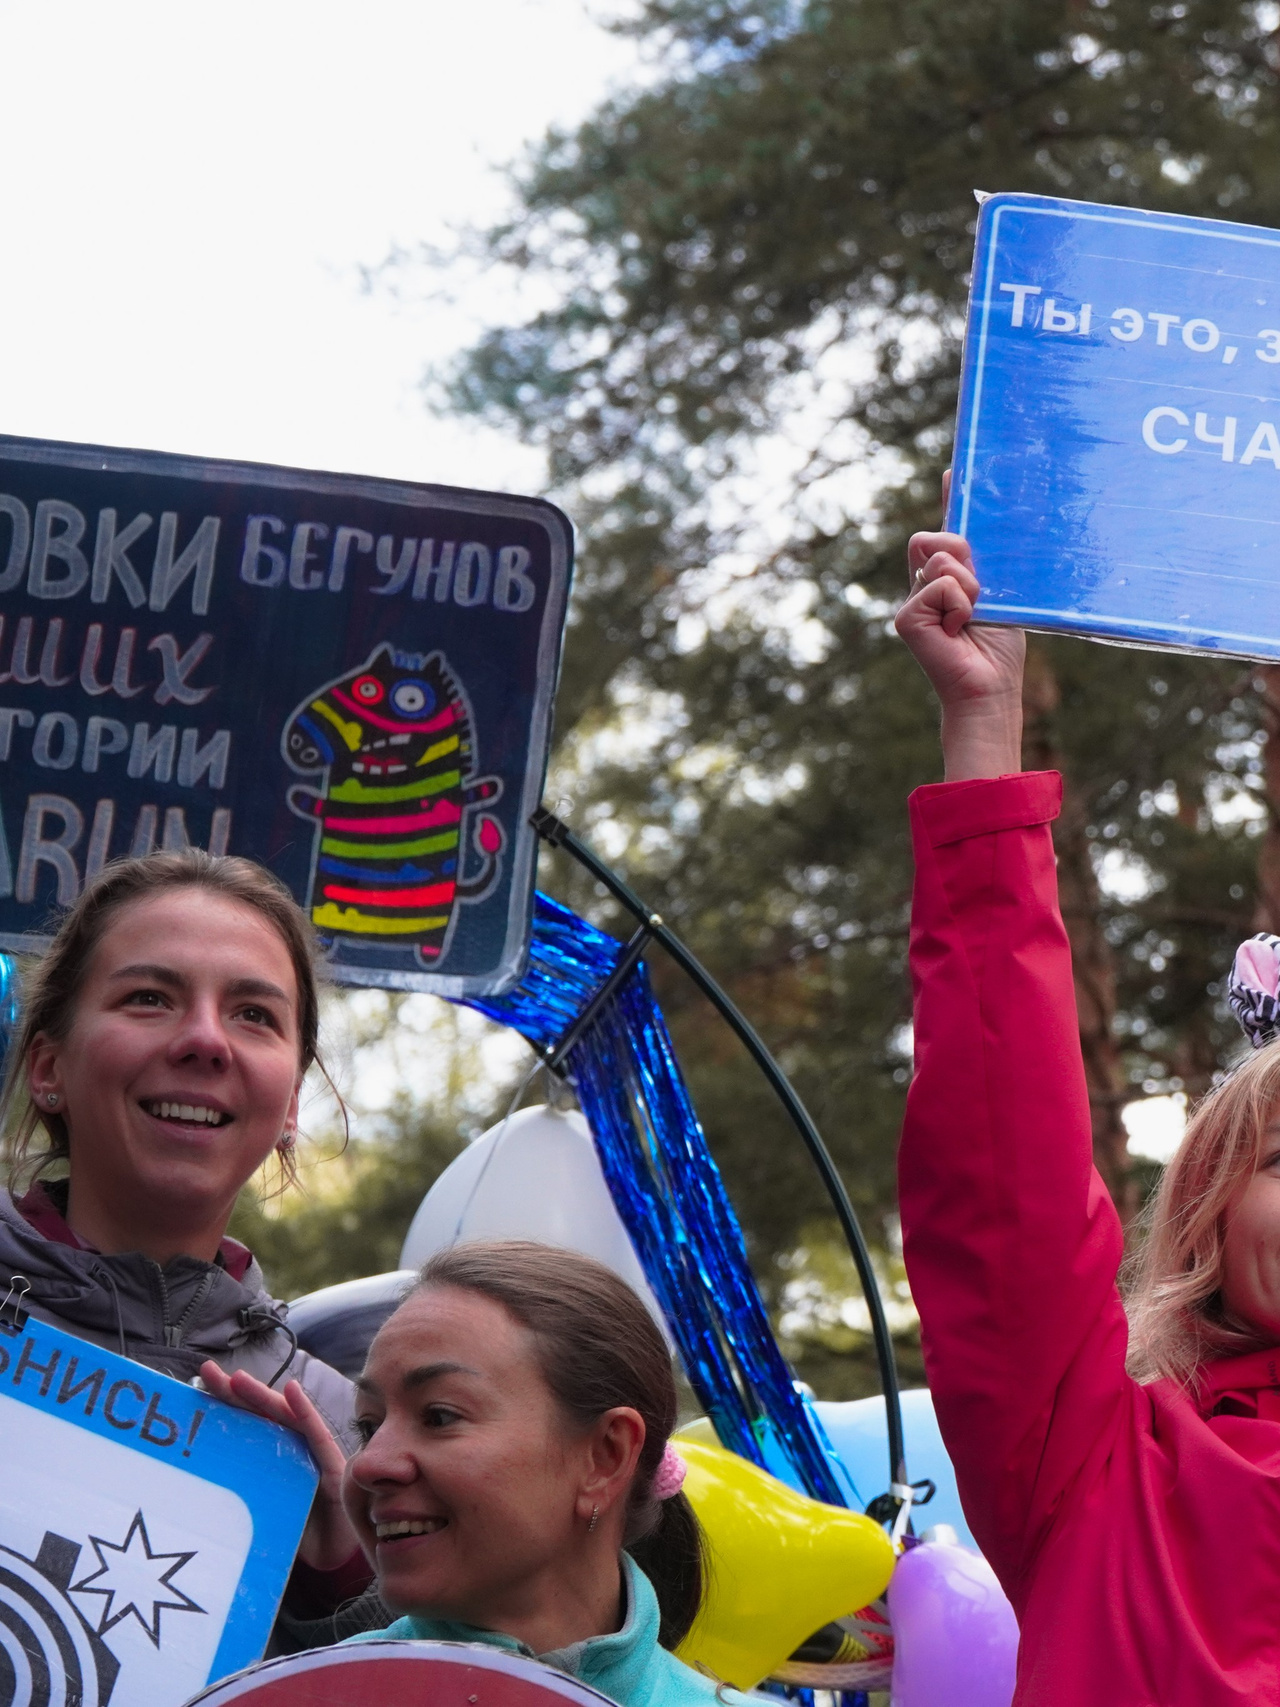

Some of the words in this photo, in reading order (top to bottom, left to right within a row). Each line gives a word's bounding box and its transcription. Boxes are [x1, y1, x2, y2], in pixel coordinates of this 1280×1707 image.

[1000, 282, 1092, 336] Ты
[1109, 307, 1239, 364] это,
[239, 513, 536, 613] БЕГУНОВ
